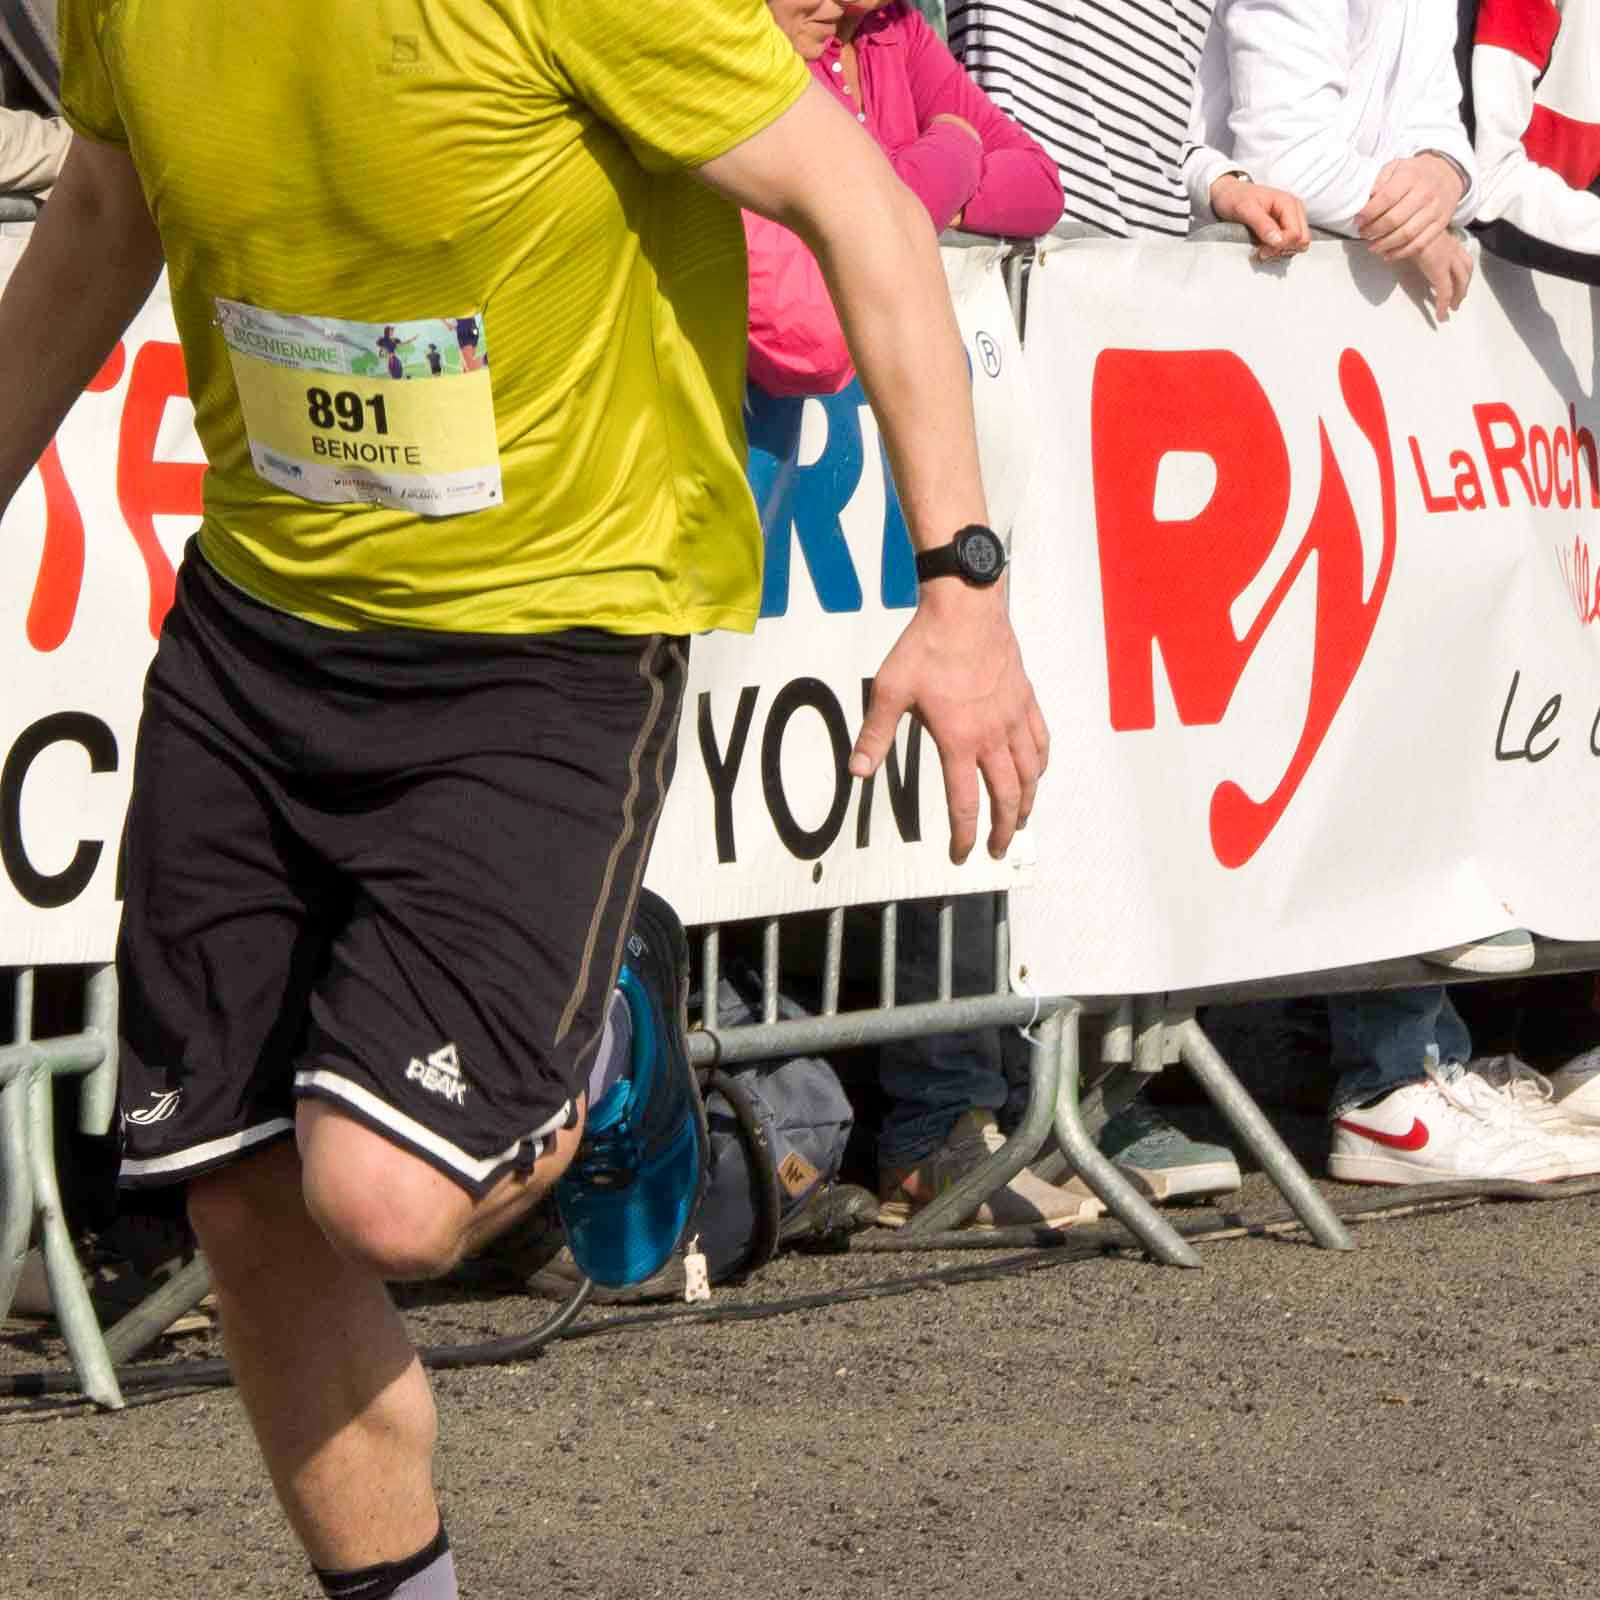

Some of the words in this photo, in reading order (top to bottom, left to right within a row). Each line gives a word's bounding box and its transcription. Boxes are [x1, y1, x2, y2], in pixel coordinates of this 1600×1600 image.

[306, 386, 389, 435] 891
[1495, 669, 1561, 763] Le
[697, 676, 922, 864] YON
[405, 1055, 467, 1106] PEAK
